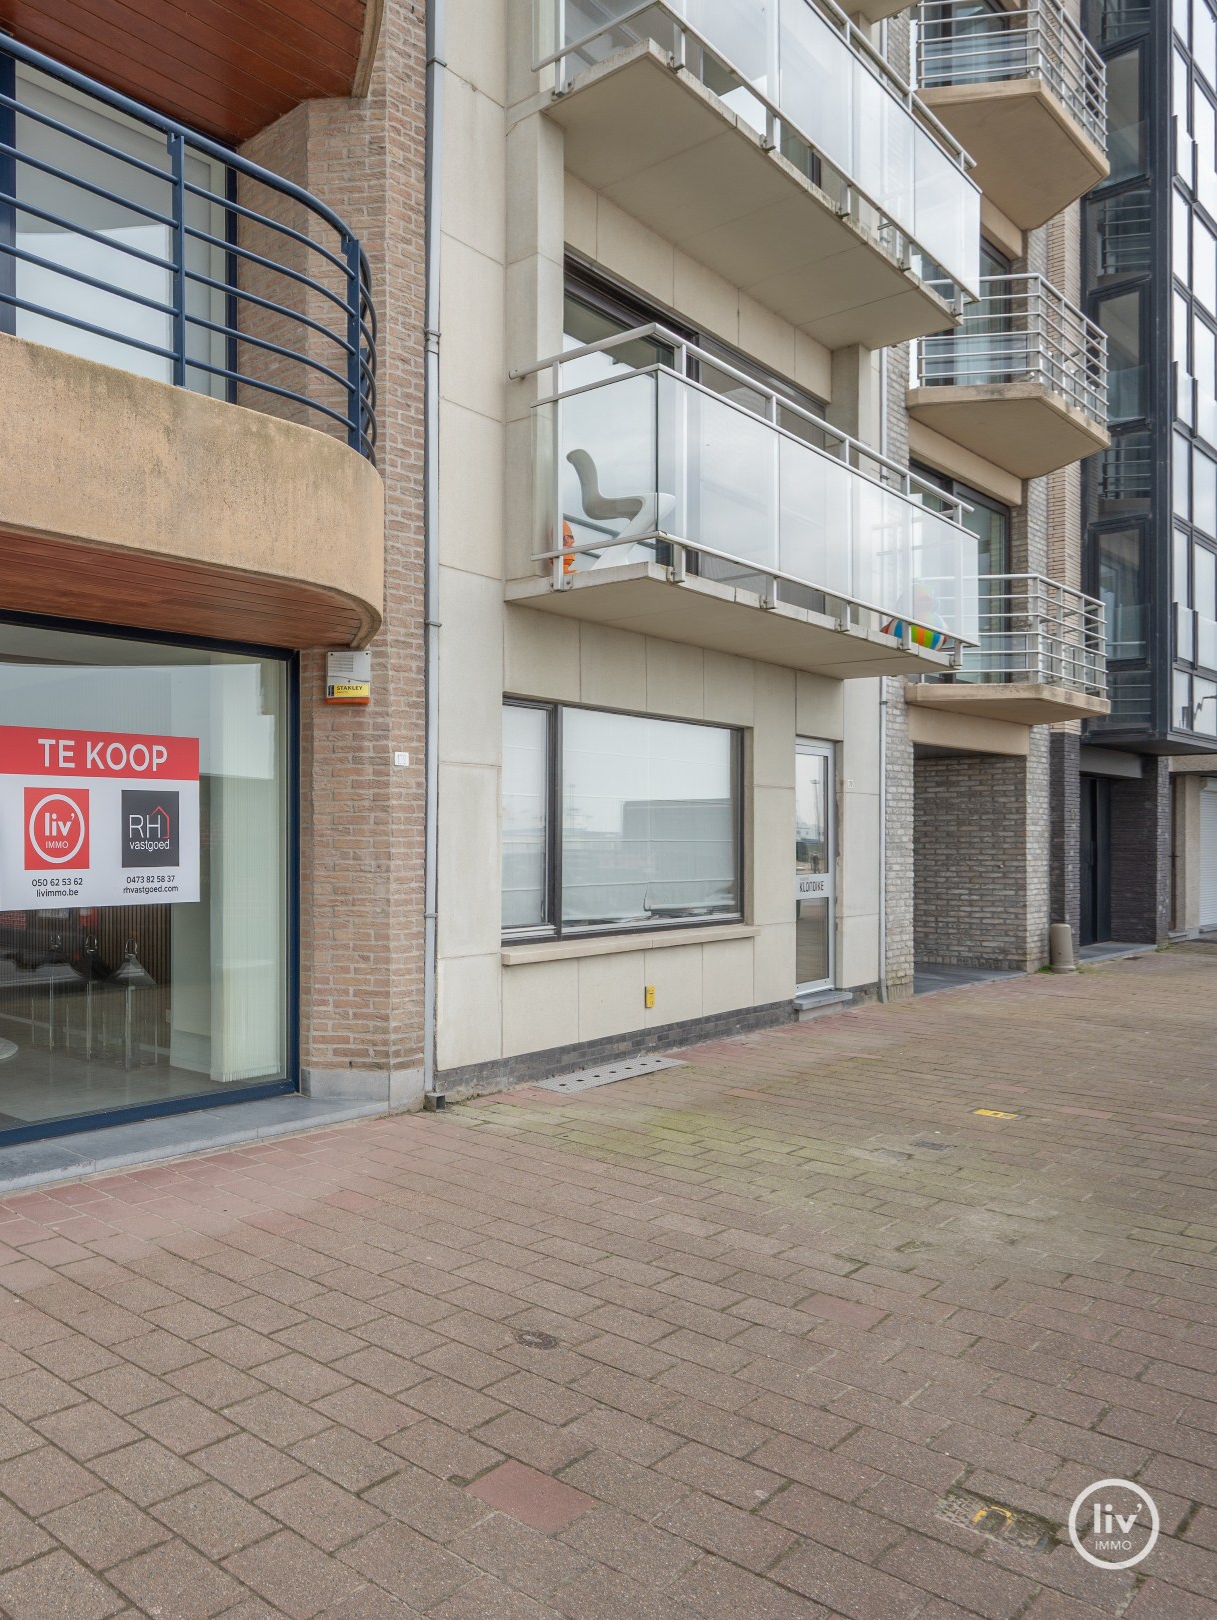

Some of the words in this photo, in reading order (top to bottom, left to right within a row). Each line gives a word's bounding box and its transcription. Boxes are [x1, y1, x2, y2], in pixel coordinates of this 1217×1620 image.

[38, 738, 76, 769] TE
[86, 741, 168, 772] KOOP
[129, 814, 161, 839] RH
[45, 840, 69, 849] IMMO
[129, 839, 170, 852] vastgoed
[31, 878, 48, 887] 050
[50, 878, 60, 887] 62
[61, 878, 72, 886] 53
[73, 877, 83, 886] 62
[126, 875, 145, 884] 0473
[146, 875, 155, 883] 82
[156, 875, 166, 883] 58
[167, 875, 175, 883] 37
[36, 888, 79, 898] livimmo.be
[123, 885, 179, 895] rhvastgoed.com
